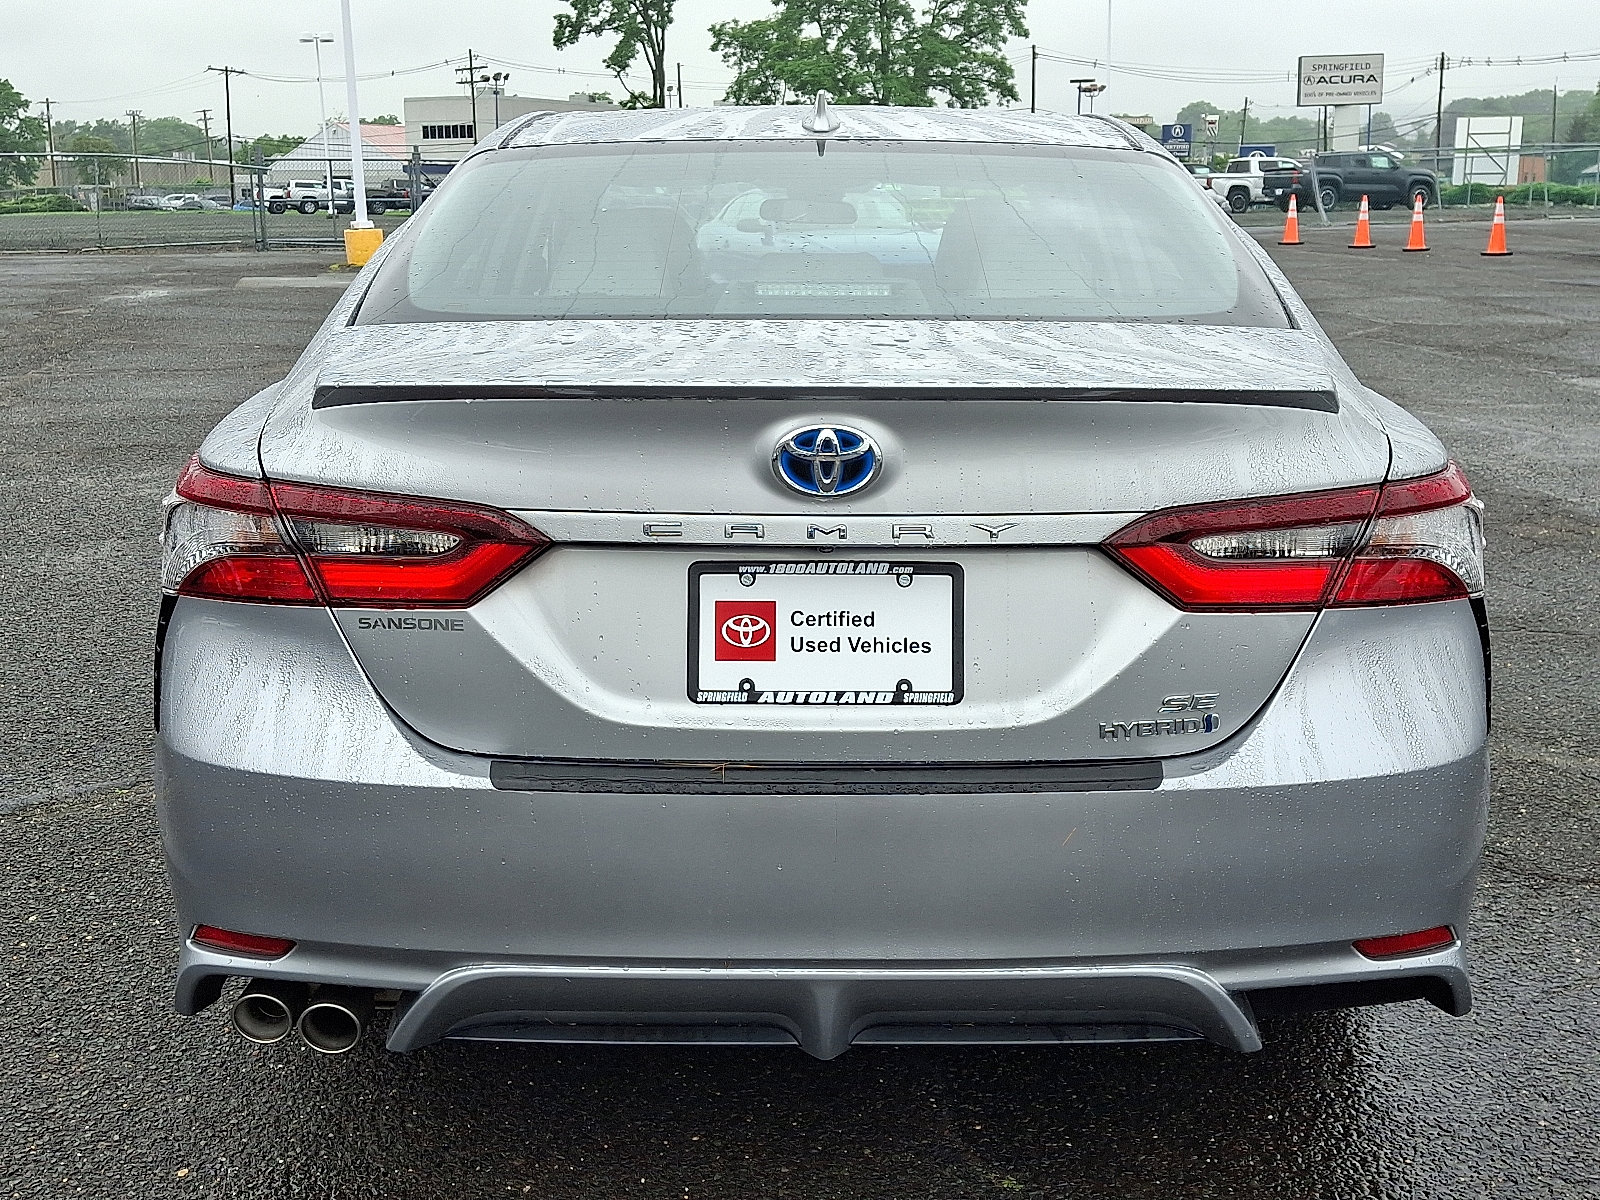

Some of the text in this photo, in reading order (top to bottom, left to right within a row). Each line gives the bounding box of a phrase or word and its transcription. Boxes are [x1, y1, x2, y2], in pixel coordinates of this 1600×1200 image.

[1311, 62, 1371, 72] SPRINGFIELD
[1316, 74, 1379, 85] ACURA
[643, 521, 1020, 541] CAMRY
[738, 562, 914, 575] www.1800AUTOLAND.com
[358, 617, 465, 632] SANSONE
[790, 610, 876, 628] Certified
[790, 636, 932, 654] Used Vehicles
[696, 691, 955, 704] SPRINGFIELD AUTOLAND SPRINGFIELD
[1157, 692, 1220, 713] SE
[1099, 717, 1201, 740] HYBRID
